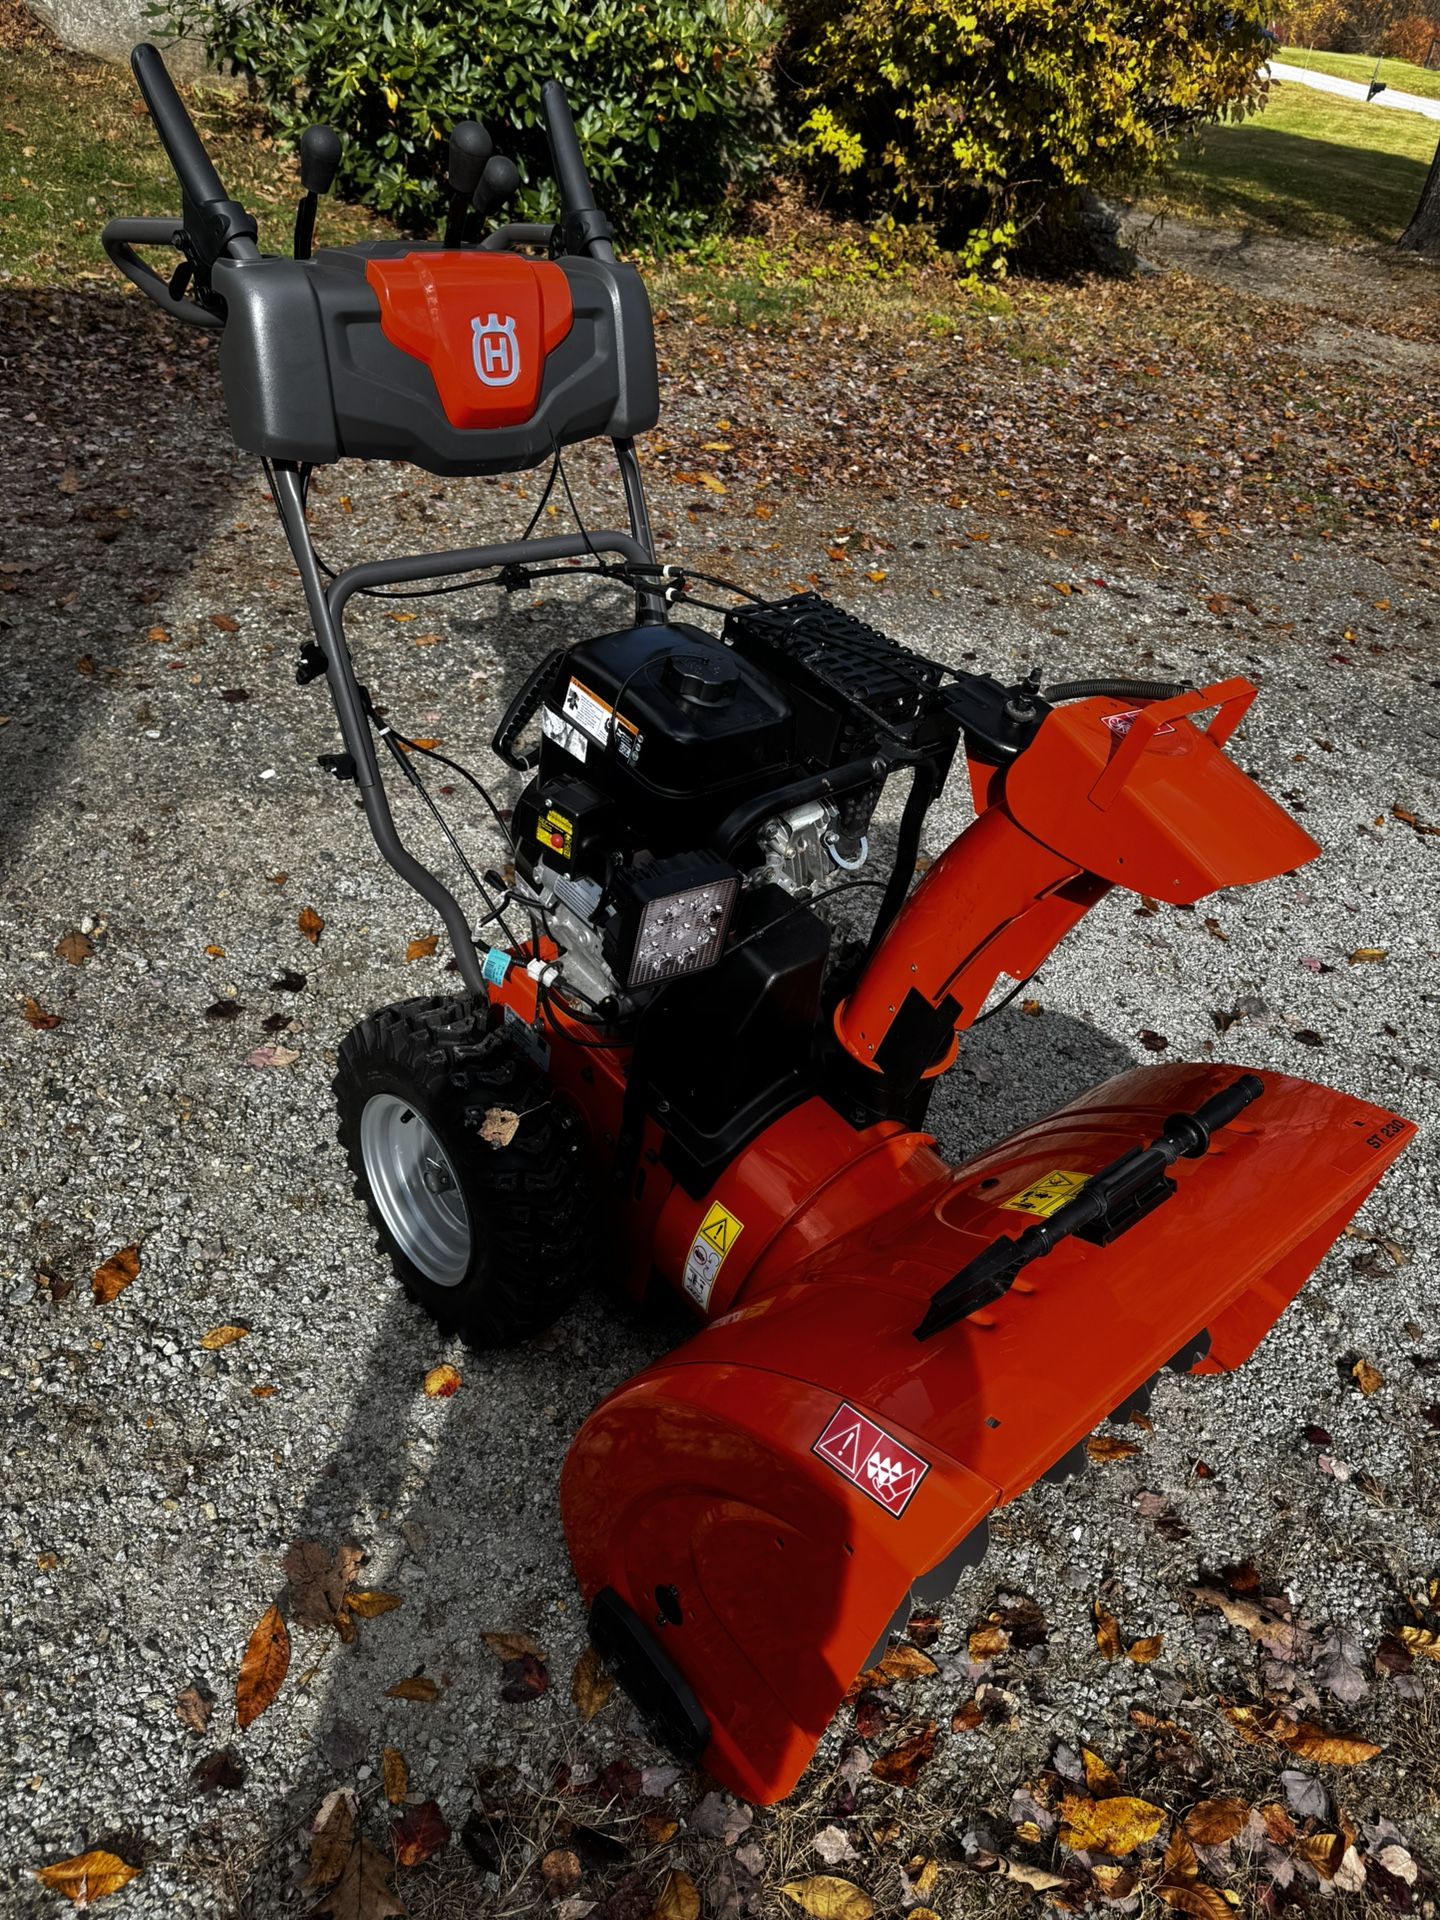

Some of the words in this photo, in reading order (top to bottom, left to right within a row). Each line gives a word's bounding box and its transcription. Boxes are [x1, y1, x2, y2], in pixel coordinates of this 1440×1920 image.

[483, 338, 509, 372] H
[1366, 1134, 1385, 1149] ST
[1380, 1119, 1405, 1138] 230
